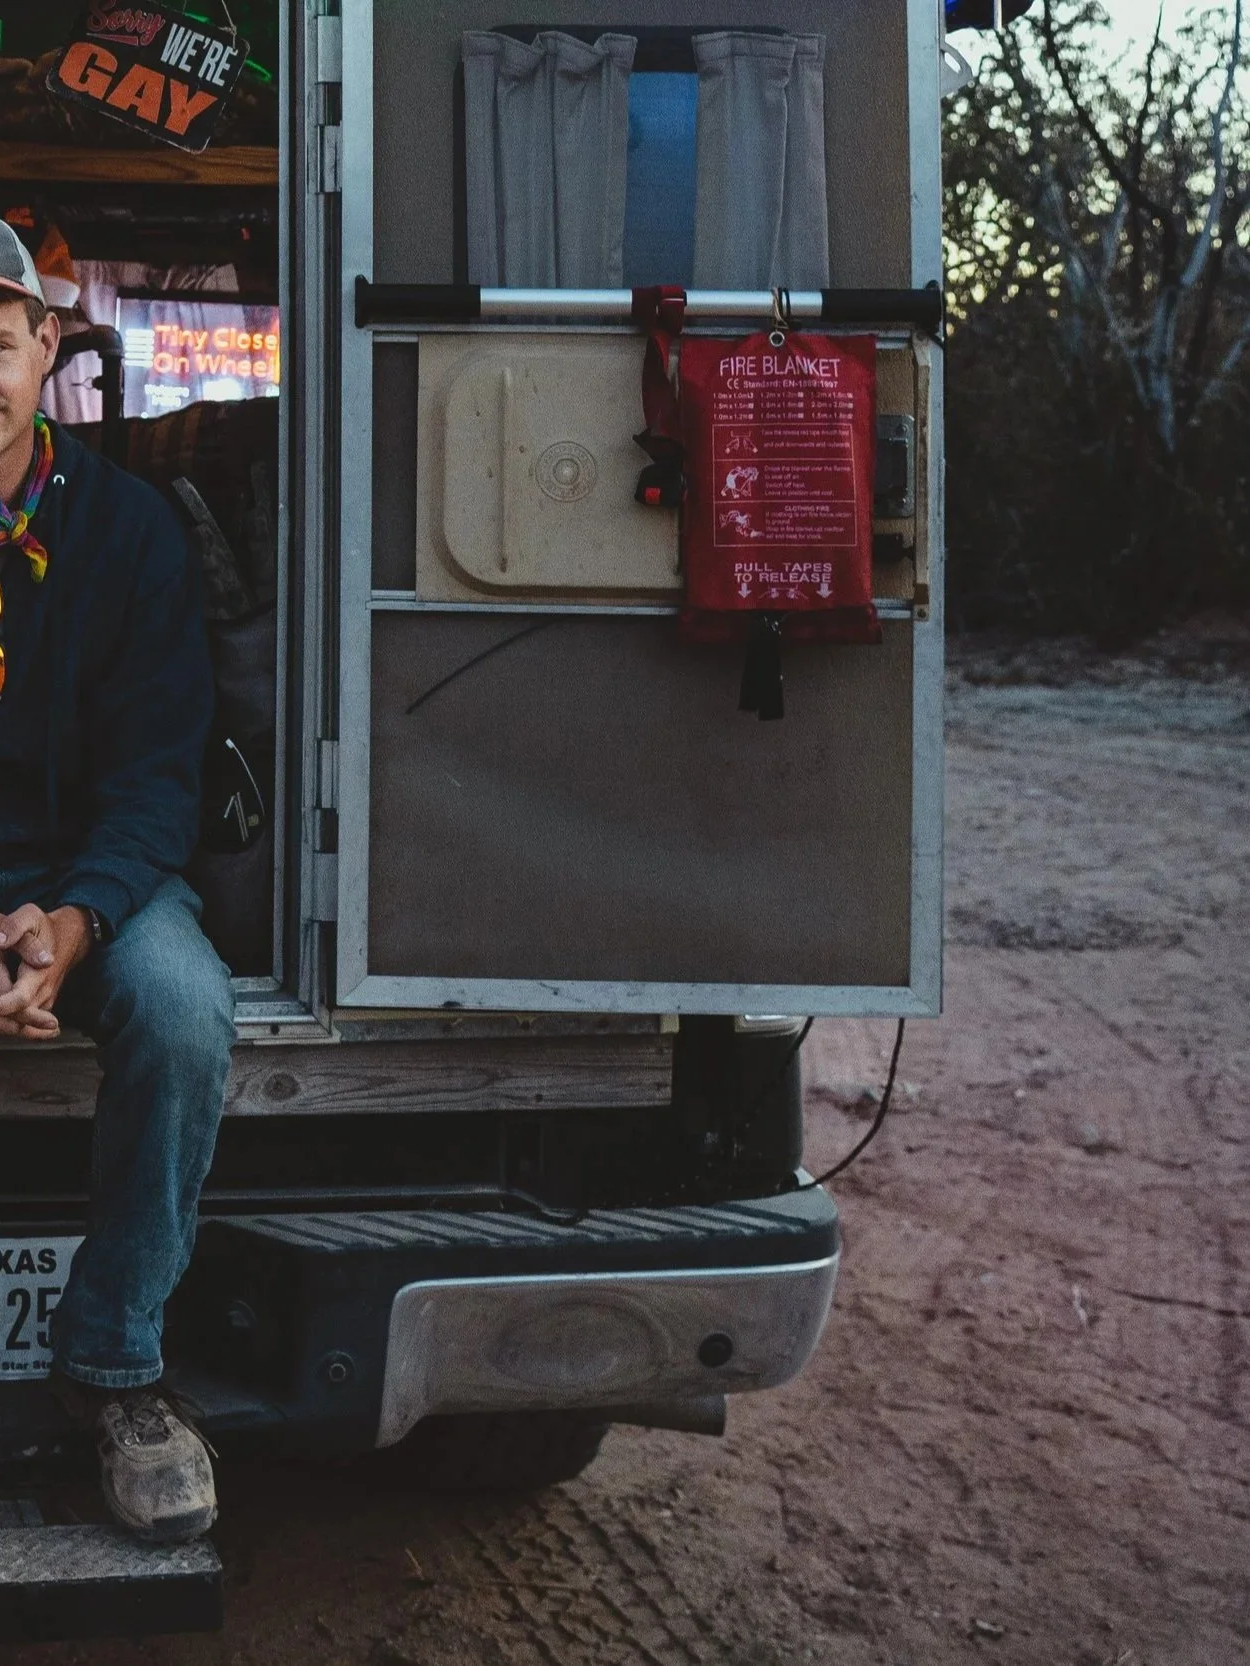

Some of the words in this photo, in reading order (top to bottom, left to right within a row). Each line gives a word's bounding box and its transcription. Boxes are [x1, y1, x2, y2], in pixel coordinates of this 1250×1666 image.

[86, 0, 166, 46] Sorry
[160, 23, 238, 87] WE'RE
[59, 41, 219, 136] GAY
[154, 324, 208, 350] Tiny
[153, 352, 190, 374] On
[719, 356, 757, 377] FIRE
[762, 355, 840, 378] BLANKET
[743, 380, 781, 388] Standard:
[734, 572, 752, 583] TO
[759, 572, 831, 583] RELEASE
[735, 563, 772, 573] PULL
[783, 563, 832, 573] TAPES
[2, 1361, 29, 1370] Star
